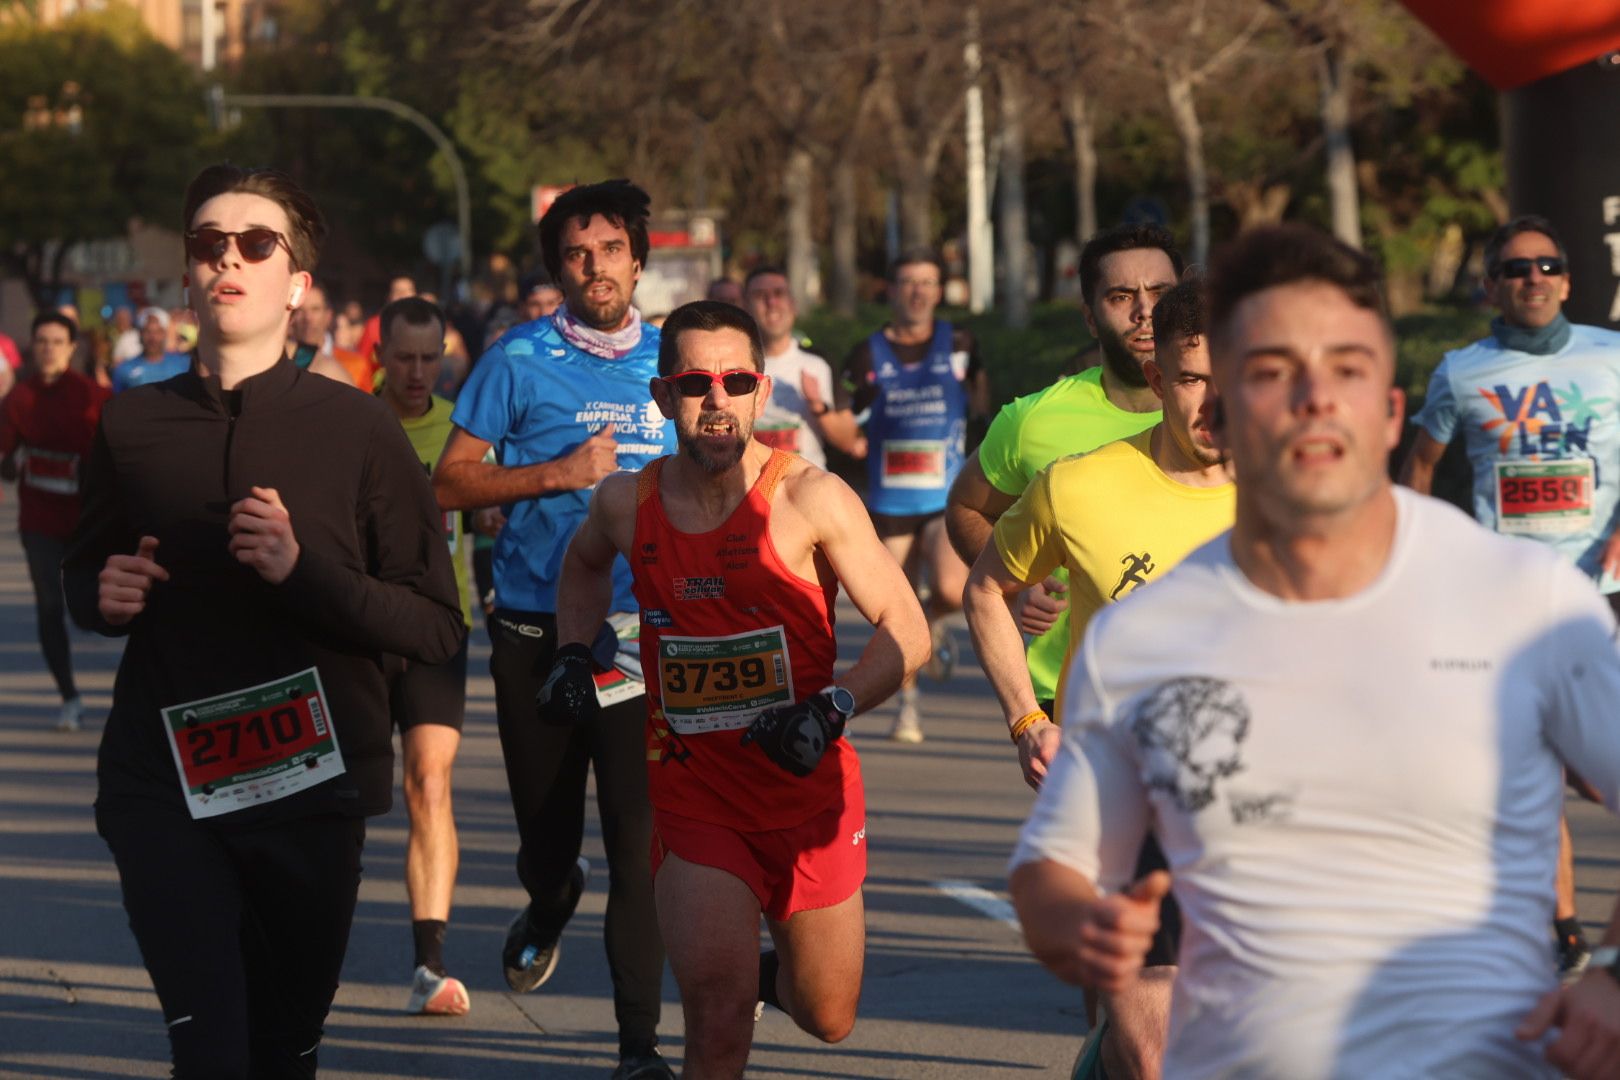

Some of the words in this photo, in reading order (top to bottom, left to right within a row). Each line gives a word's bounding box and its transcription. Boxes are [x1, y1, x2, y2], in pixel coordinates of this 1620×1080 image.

[575, 411, 633, 423] EMPRESAS
[625, 404, 636, 413] DE
[1503, 479, 1579, 504] 2559
[686, 577, 724, 586] TRAIL
[665, 657, 767, 694] 3739
[187, 706, 303, 768] 2710
